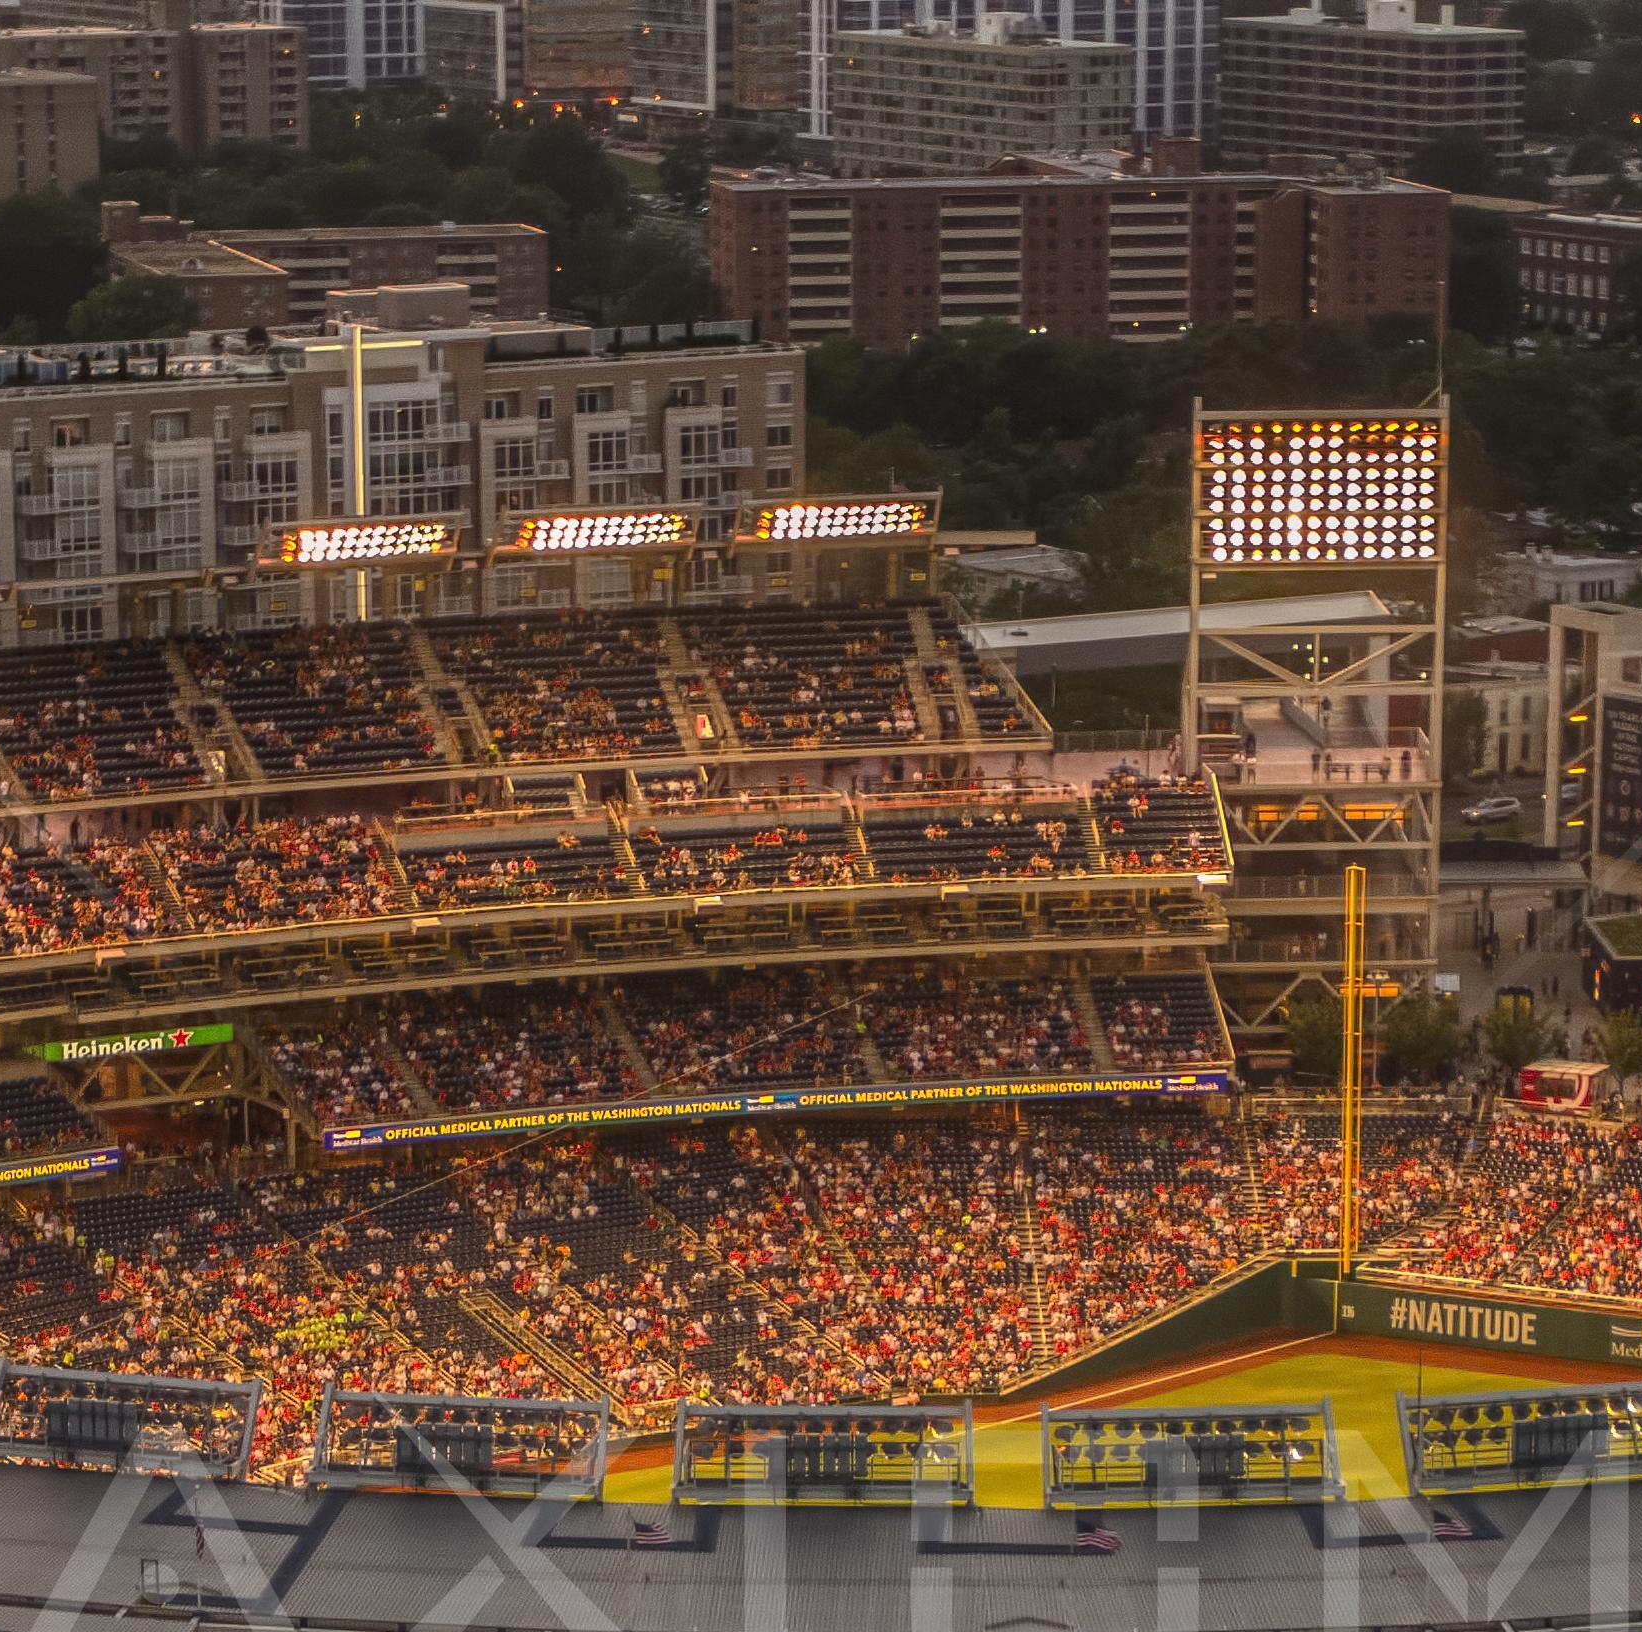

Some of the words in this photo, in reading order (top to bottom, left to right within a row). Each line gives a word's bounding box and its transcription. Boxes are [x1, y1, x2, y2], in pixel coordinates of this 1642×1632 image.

[62, 1036, 163, 1060] Heineken
[800, 1094, 854, 1106] OFFICIAL
[856, 1090, 908, 1103] MEDICAL
[910, 1085, 963, 1099] PARTNER
[965, 1085, 983, 1097] OF
[985, 1084, 1008, 1095] THE
[1010, 1081, 1092, 1095] WASHINGTON
[1095, 1079, 1163, 1091] NATIONALS
[385, 1125, 438, 1140] OFFICIAL
[440, 1120, 492, 1134] MEDICAL
[494, 1115, 545, 1130] PARTNER
[548, 1113, 565, 1125] OF
[567, 1111, 589, 1123] THE
[591, 1105, 672, 1120] WASHINGTON
[675, 1100, 741, 1114] NATIONALS
[33, 1158, 89, 1177] NATIONALS
[1390, 1298, 1537, 1345] #NATITUDE
